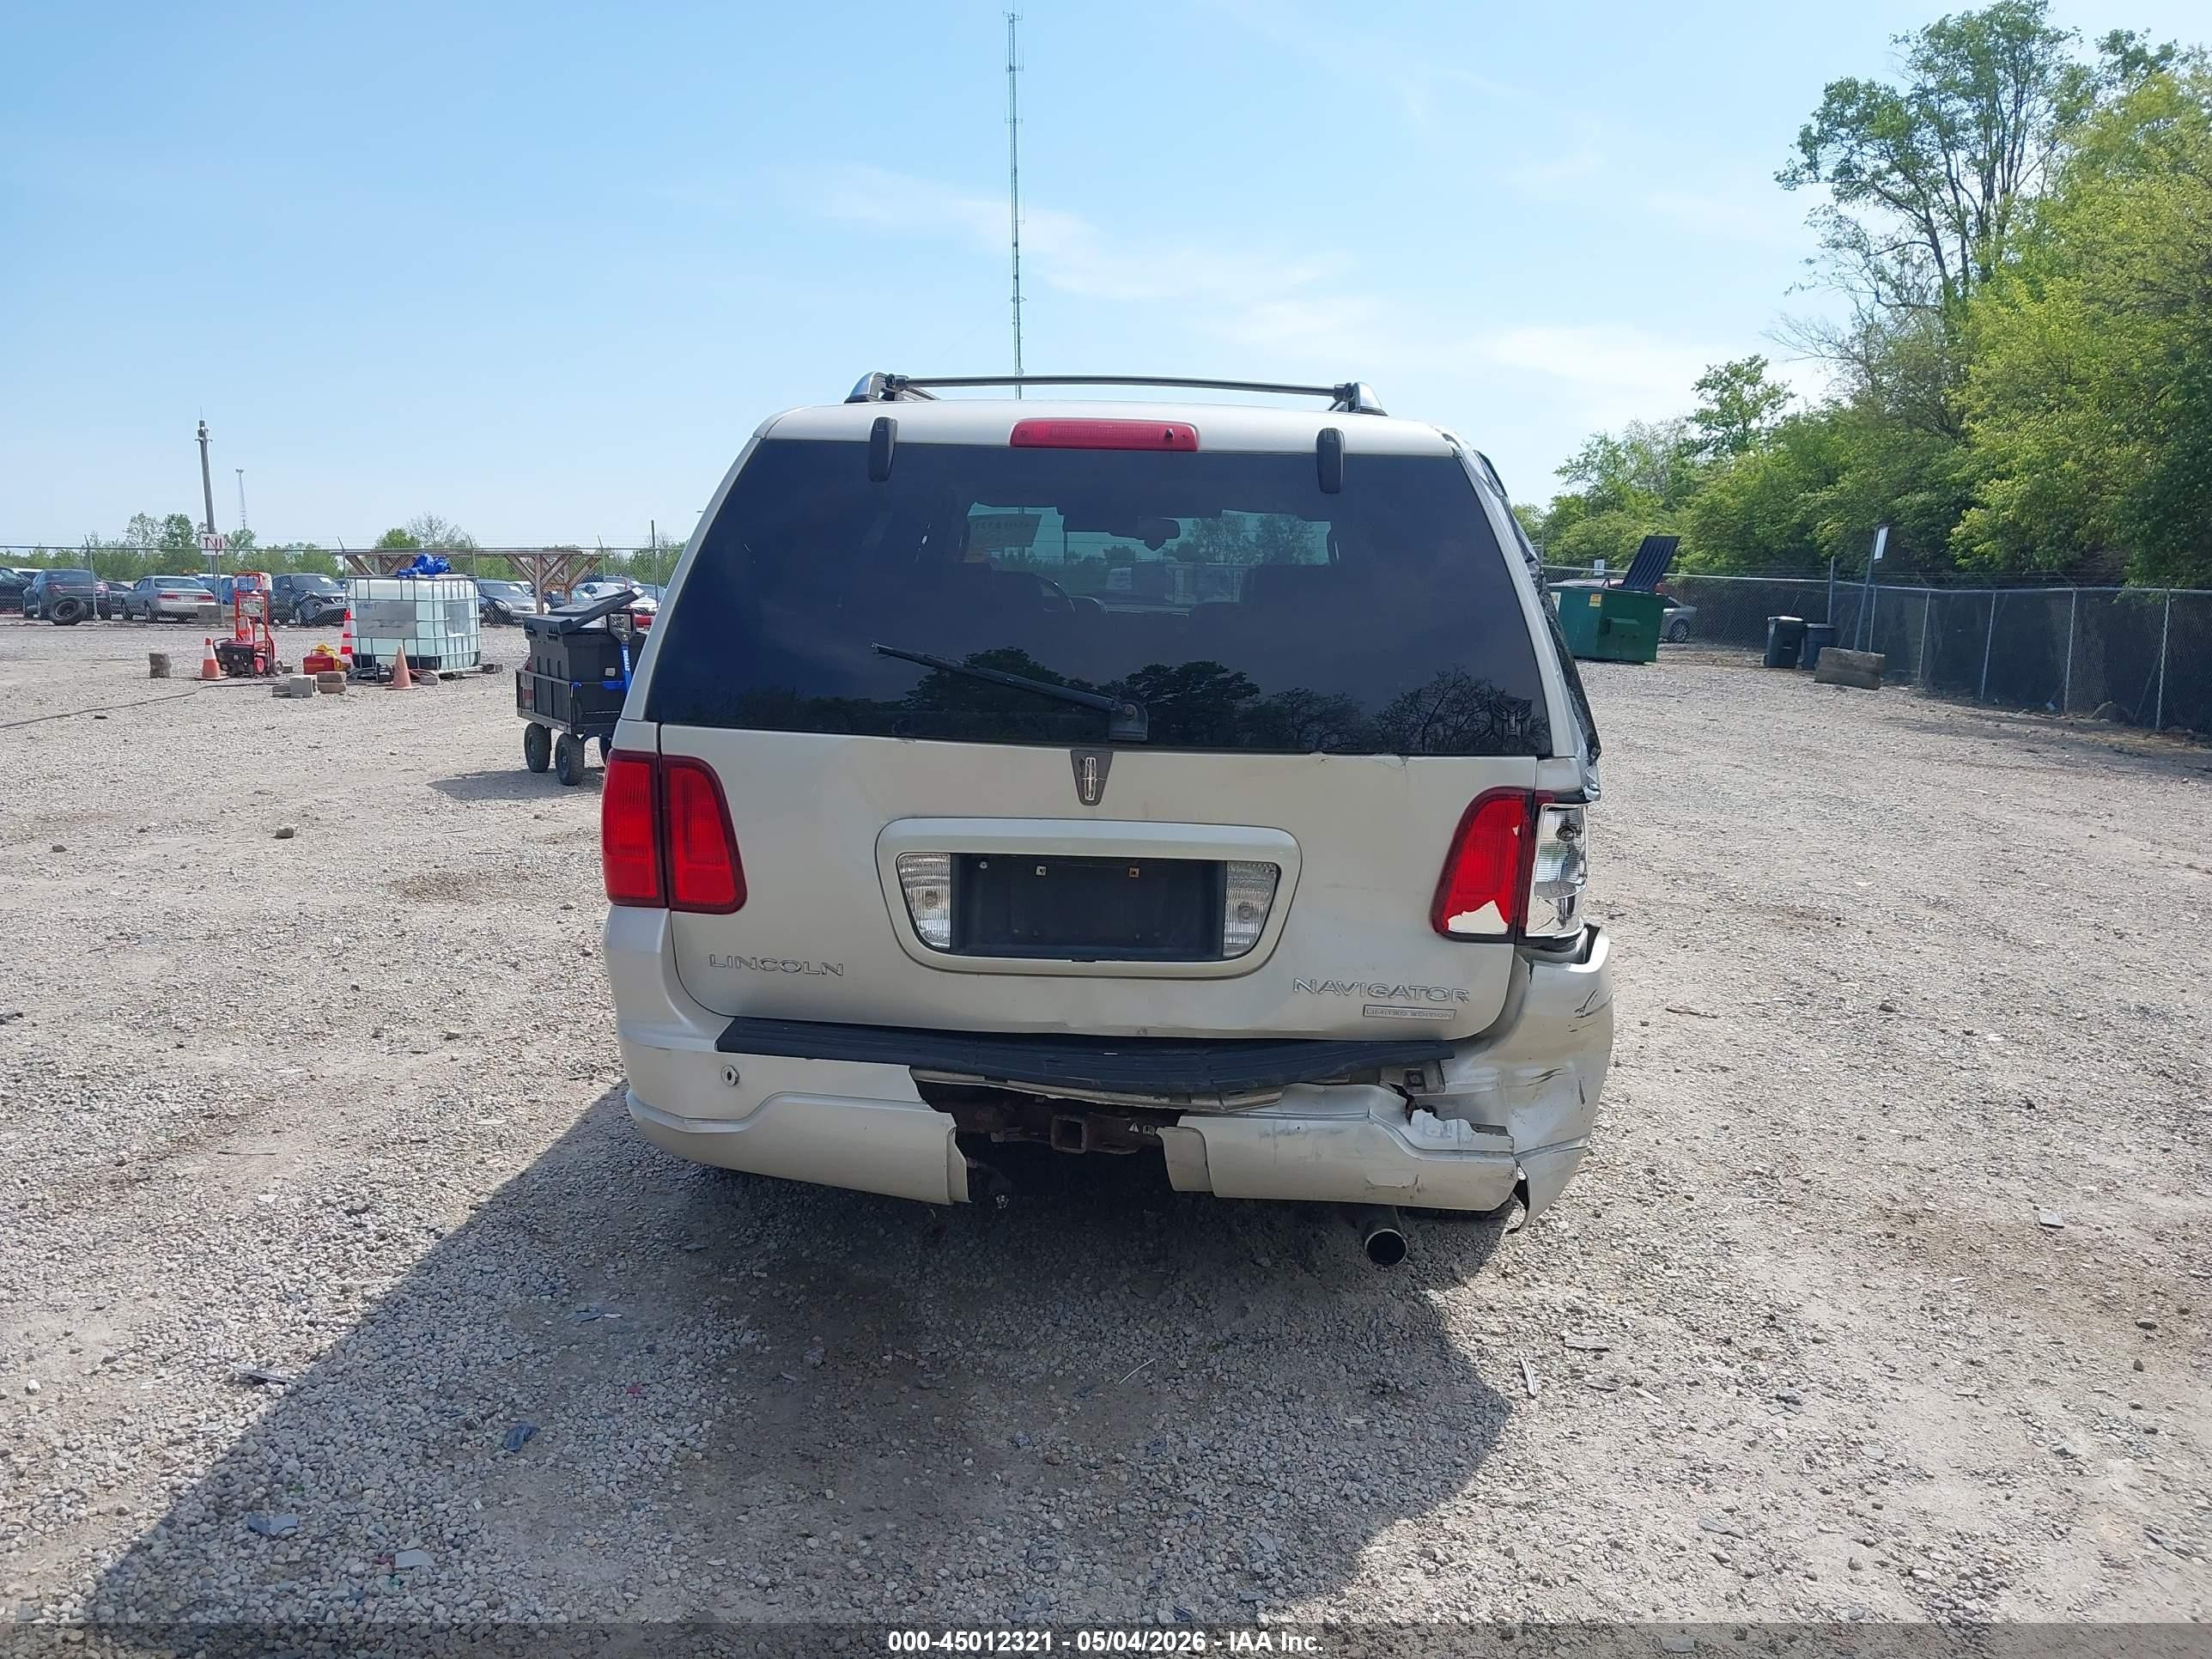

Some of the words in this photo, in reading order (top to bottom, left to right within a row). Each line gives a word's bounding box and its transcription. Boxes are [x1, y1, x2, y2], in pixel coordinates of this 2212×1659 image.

[708, 953, 844, 976] LINCOLN
[1292, 977, 1470, 1004] NAVIGATOR
[1365, 1008, 1407, 1017] LIMITED
[1410, 1010, 1452, 1018] EDITION
